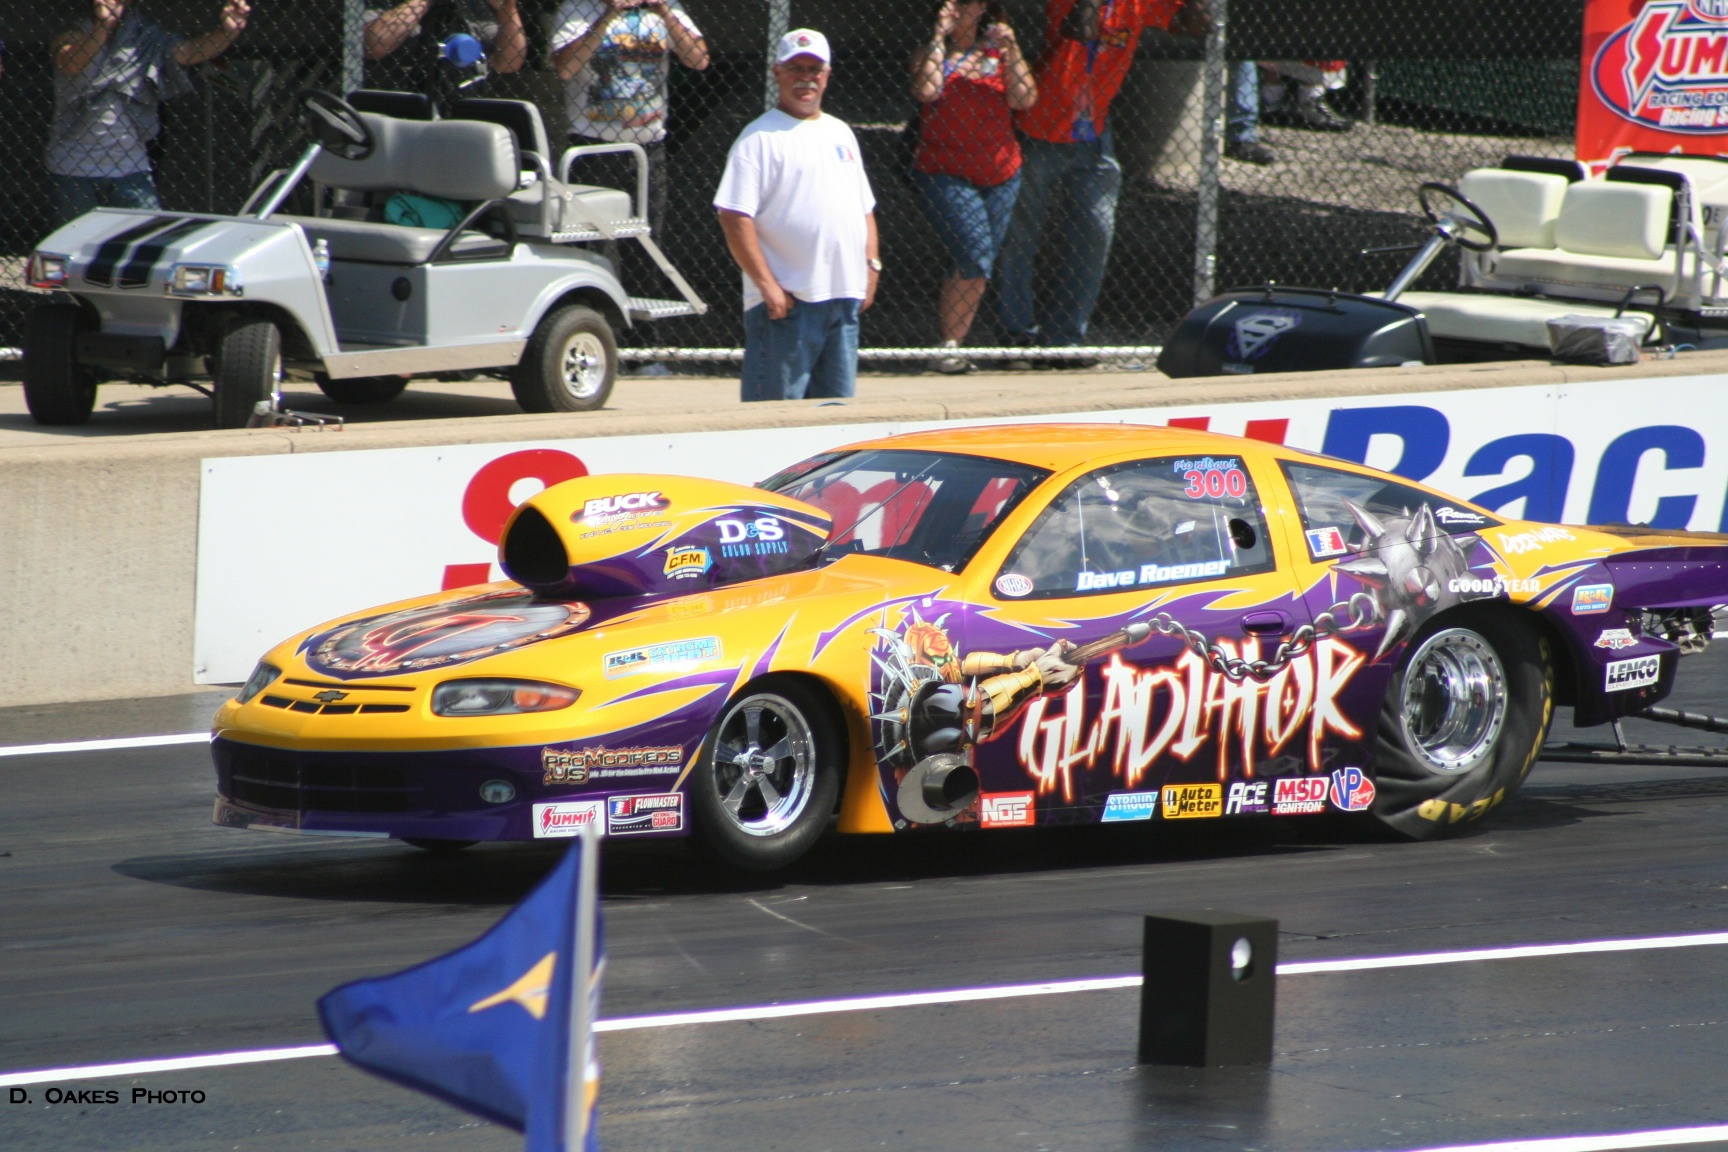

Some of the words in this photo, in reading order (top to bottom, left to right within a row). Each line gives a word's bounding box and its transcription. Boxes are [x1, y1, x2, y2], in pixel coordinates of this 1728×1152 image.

[1648, 92, 1703, 107] RACING
[1704, 91, 1728, 106] EQ
[1660, 107, 1717, 127] Racing
[1184, 468, 1247, 499] 300
[583, 492, 660, 517] BUCK
[715, 518, 784, 544] D&S
[721, 545, 751, 558] COLOR
[755, 541, 788, 555] SUPPLY
[1001, 578, 1029, 592] NHRA
[1076, 571, 1136, 592] Dave
[1138, 559, 1232, 584] Roemer
[649, 638, 716, 659] EXTREME
[1608, 658, 1658, 684] LENCO
[1018, 635, 1365, 803] GLADIATOR
[1180, 788, 1213, 801] Auto
[1226, 783, 1268, 814] ACE
[1278, 780, 1325, 802] MSD
[1332, 767, 1363, 810] VP
[634, 797, 679, 814] FLOWMASTER
[982, 797, 1032, 822] NOS
[1109, 794, 1153, 811] STROUD
[1180, 800, 1219, 812] Meter
[1276, 802, 1322, 814] IGNITION
[653, 816, 676, 827] GUARD
